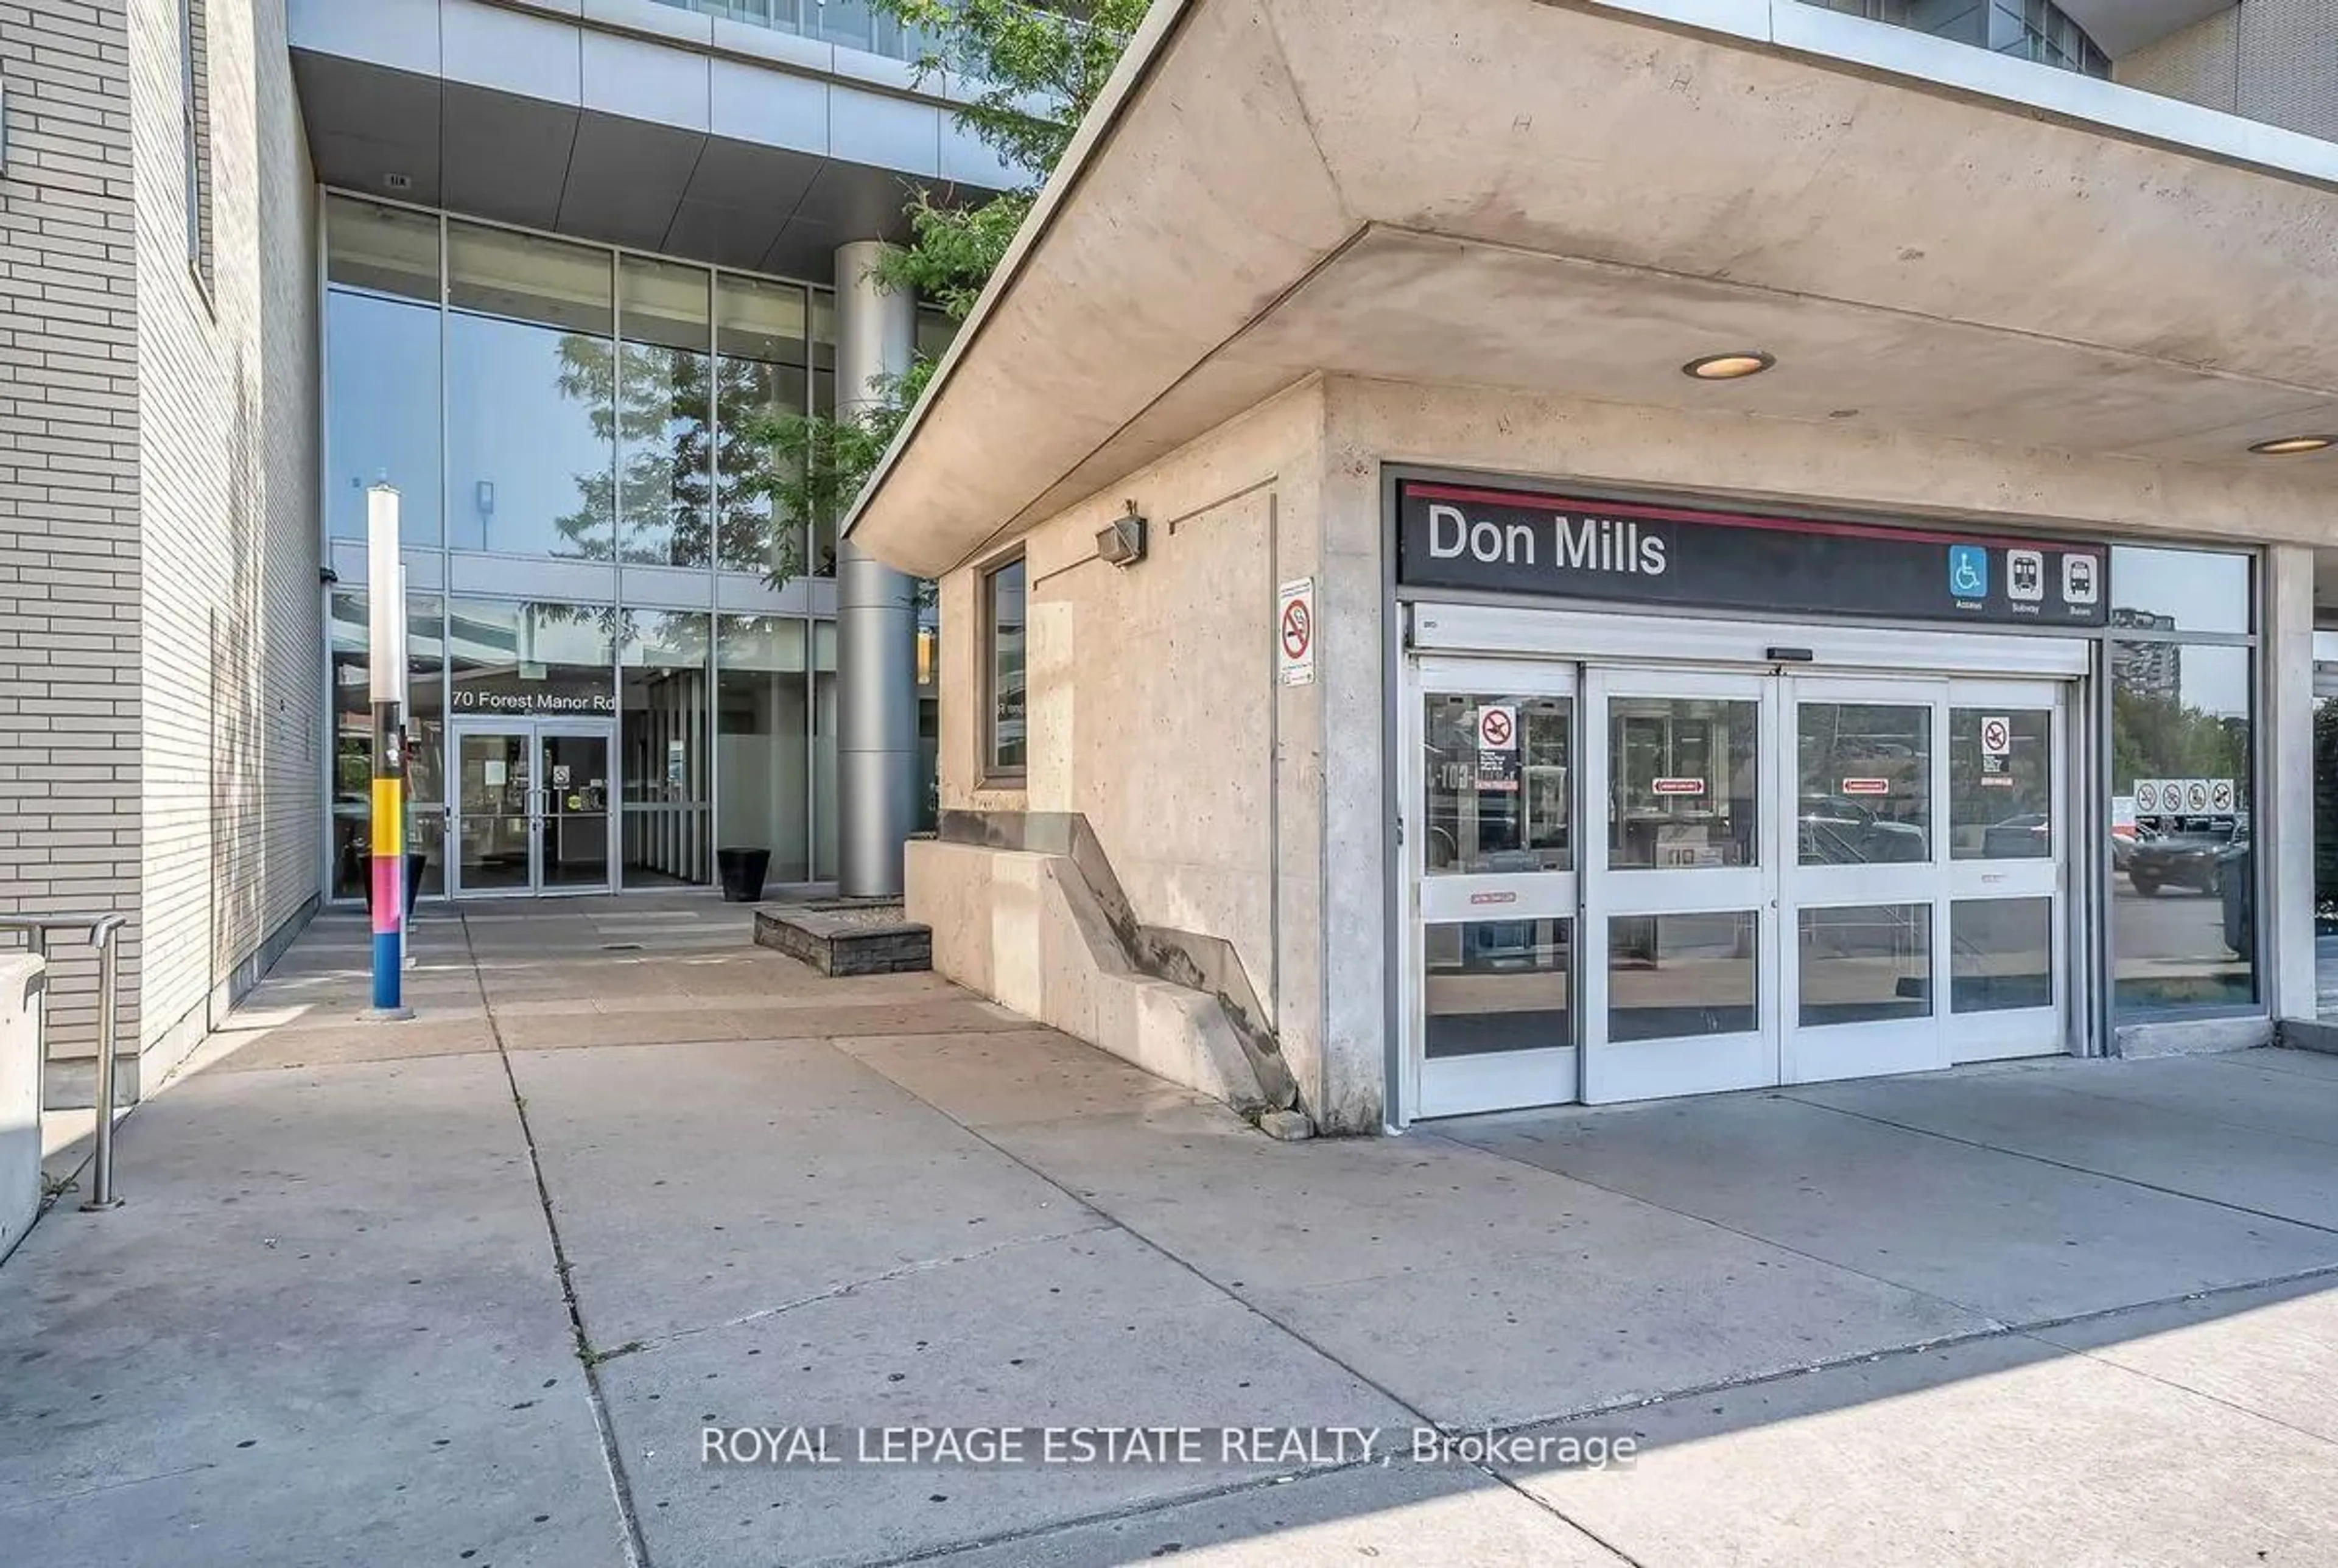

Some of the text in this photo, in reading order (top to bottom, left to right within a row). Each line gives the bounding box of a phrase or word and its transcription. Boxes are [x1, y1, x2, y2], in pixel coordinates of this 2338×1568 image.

[1429, 505, 1667, 575] Don Mills
[452, 691, 616, 710] 70 Forest Manor Rd
